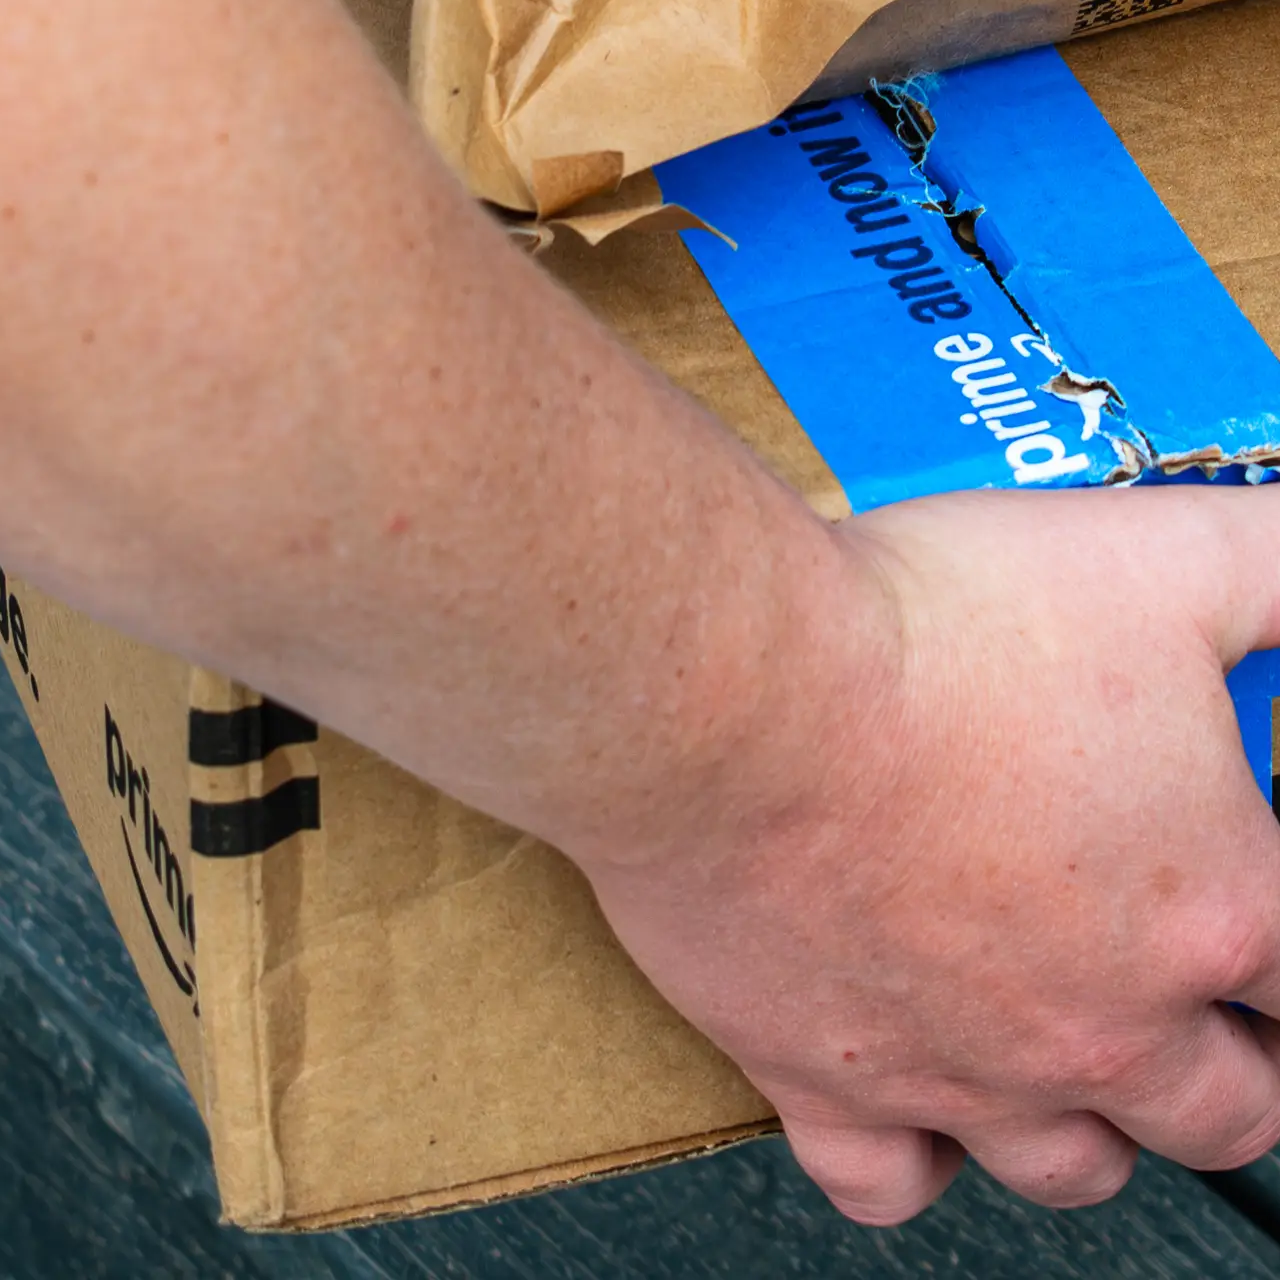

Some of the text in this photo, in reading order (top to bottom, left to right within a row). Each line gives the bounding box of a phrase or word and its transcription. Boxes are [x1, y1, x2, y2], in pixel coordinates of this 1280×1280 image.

[799, 136, 911, 234] now
[850, 235, 972, 324] and
[933, 332, 1091, 485] prime
